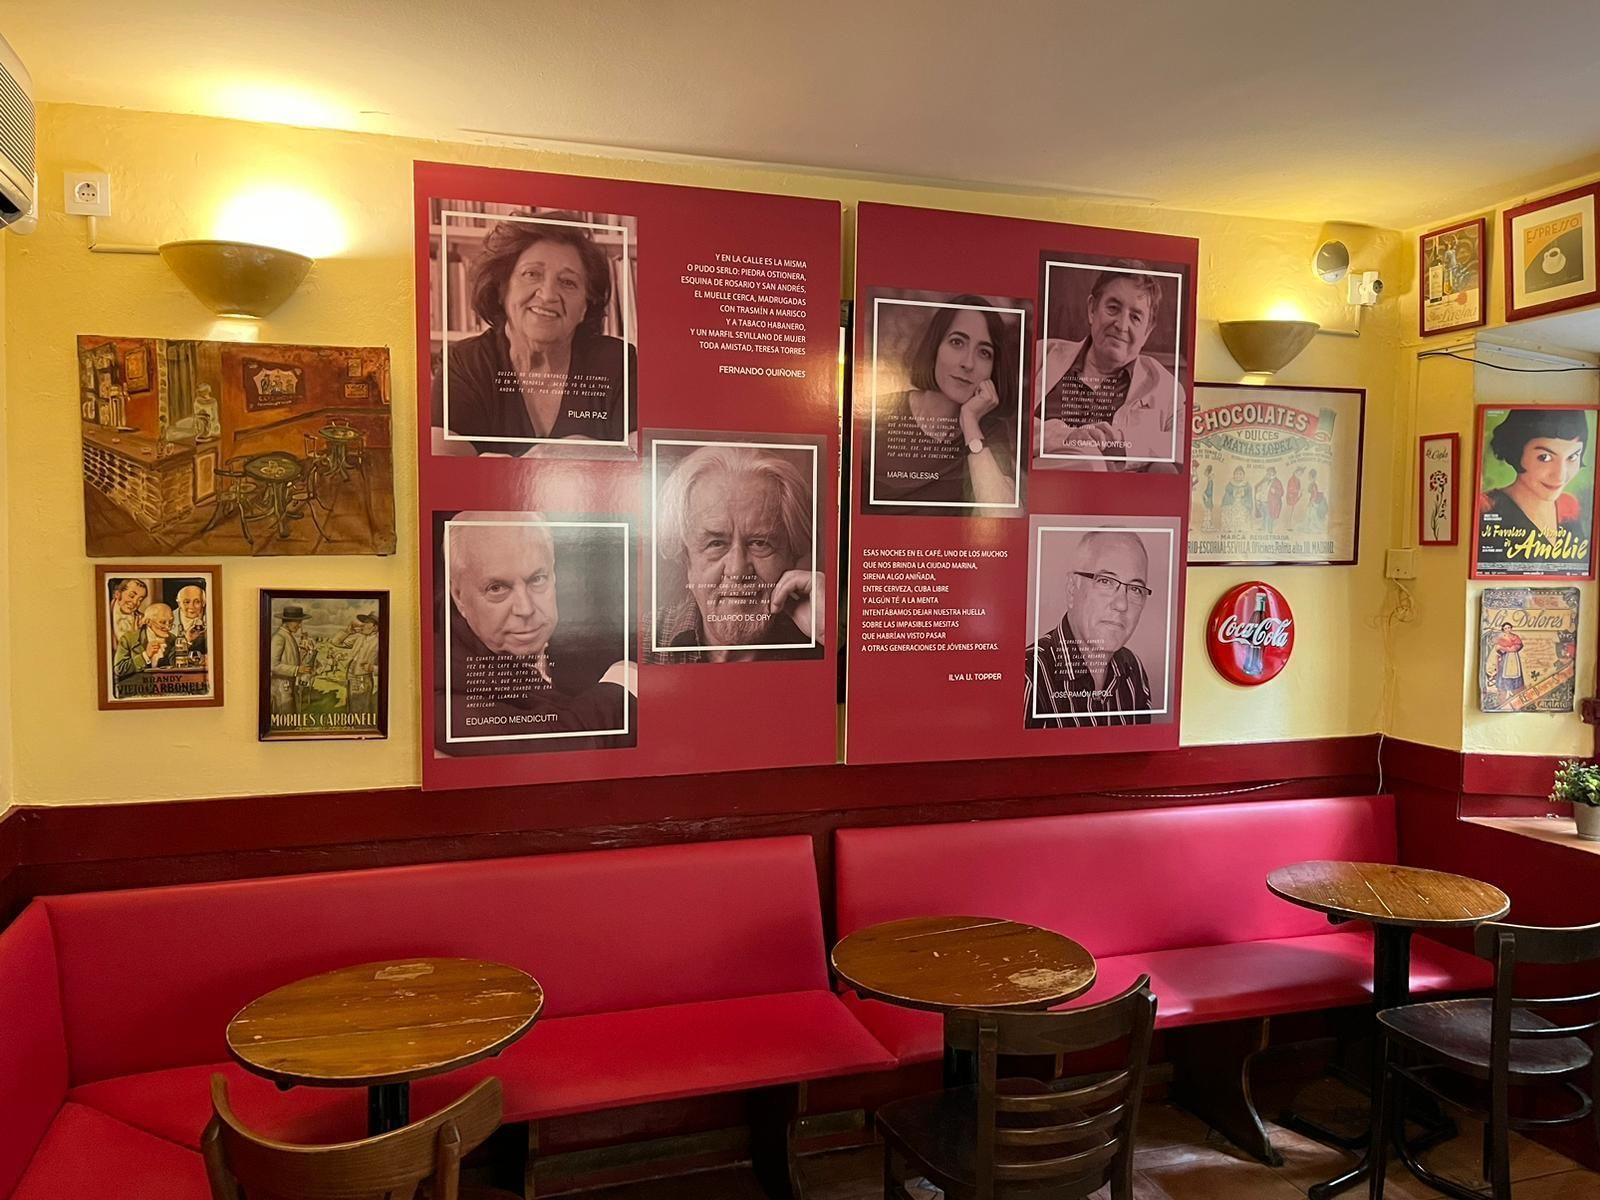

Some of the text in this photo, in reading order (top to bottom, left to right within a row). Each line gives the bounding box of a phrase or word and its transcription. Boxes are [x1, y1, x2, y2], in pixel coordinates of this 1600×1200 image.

[1526, 218, 1579, 244] ESPRESSO
[742, 256, 763, 264] CALLE
[784, 260, 807, 268] MISMA
[694, 264, 715, 273] PUDO
[716, 266, 740, 276] SERLO:
[741, 268, 766, 277] PIEDRA
[767, 270, 807, 281] OSTIONERA,
[681, 276, 713, 286] ESQUINA
[724, 279, 755, 289] ROSARIO
[777, 283, 807, 294] ANDRÉS,
[704, 291, 731, 300] MUELLE
[732, 293, 757, 303] CERCA,
[758, 295, 806, 306] MADRUGADAS
[720, 305, 735, 313] CON
[738, 305, 768, 315] TRASMÍN
[776, 309, 806, 318] MARISCO
[739, 319, 766, 328] TABACO
[767, 321, 806, 331] HABANERO,
[708, 330, 733, 338] MARFIL
[735, 331, 772, 340] SEVILLANO
[784, 335, 806, 343] MUJER
[700, 341, 806, 355] TODA AMISTAD, TERESA TORRES
[719, 366, 806, 378] FERNANDO QUIÑONES
[568, 410, 608, 420] PILAR PAZ
[1192, 404, 1310, 435] CHOCOLATES
[1244, 430, 1280, 440] DULCES
[1493, 525, 1526, 537] Favoloso
[925, 549, 943, 558] CAFÉ,
[892, 595, 900, 603] TÉ
[1512, 609, 1564, 628] Dolores
[271, 713, 377, 726] MORILES CARBONELL
[466, 714, 558, 725] EDUARDO MENDICUTTI
